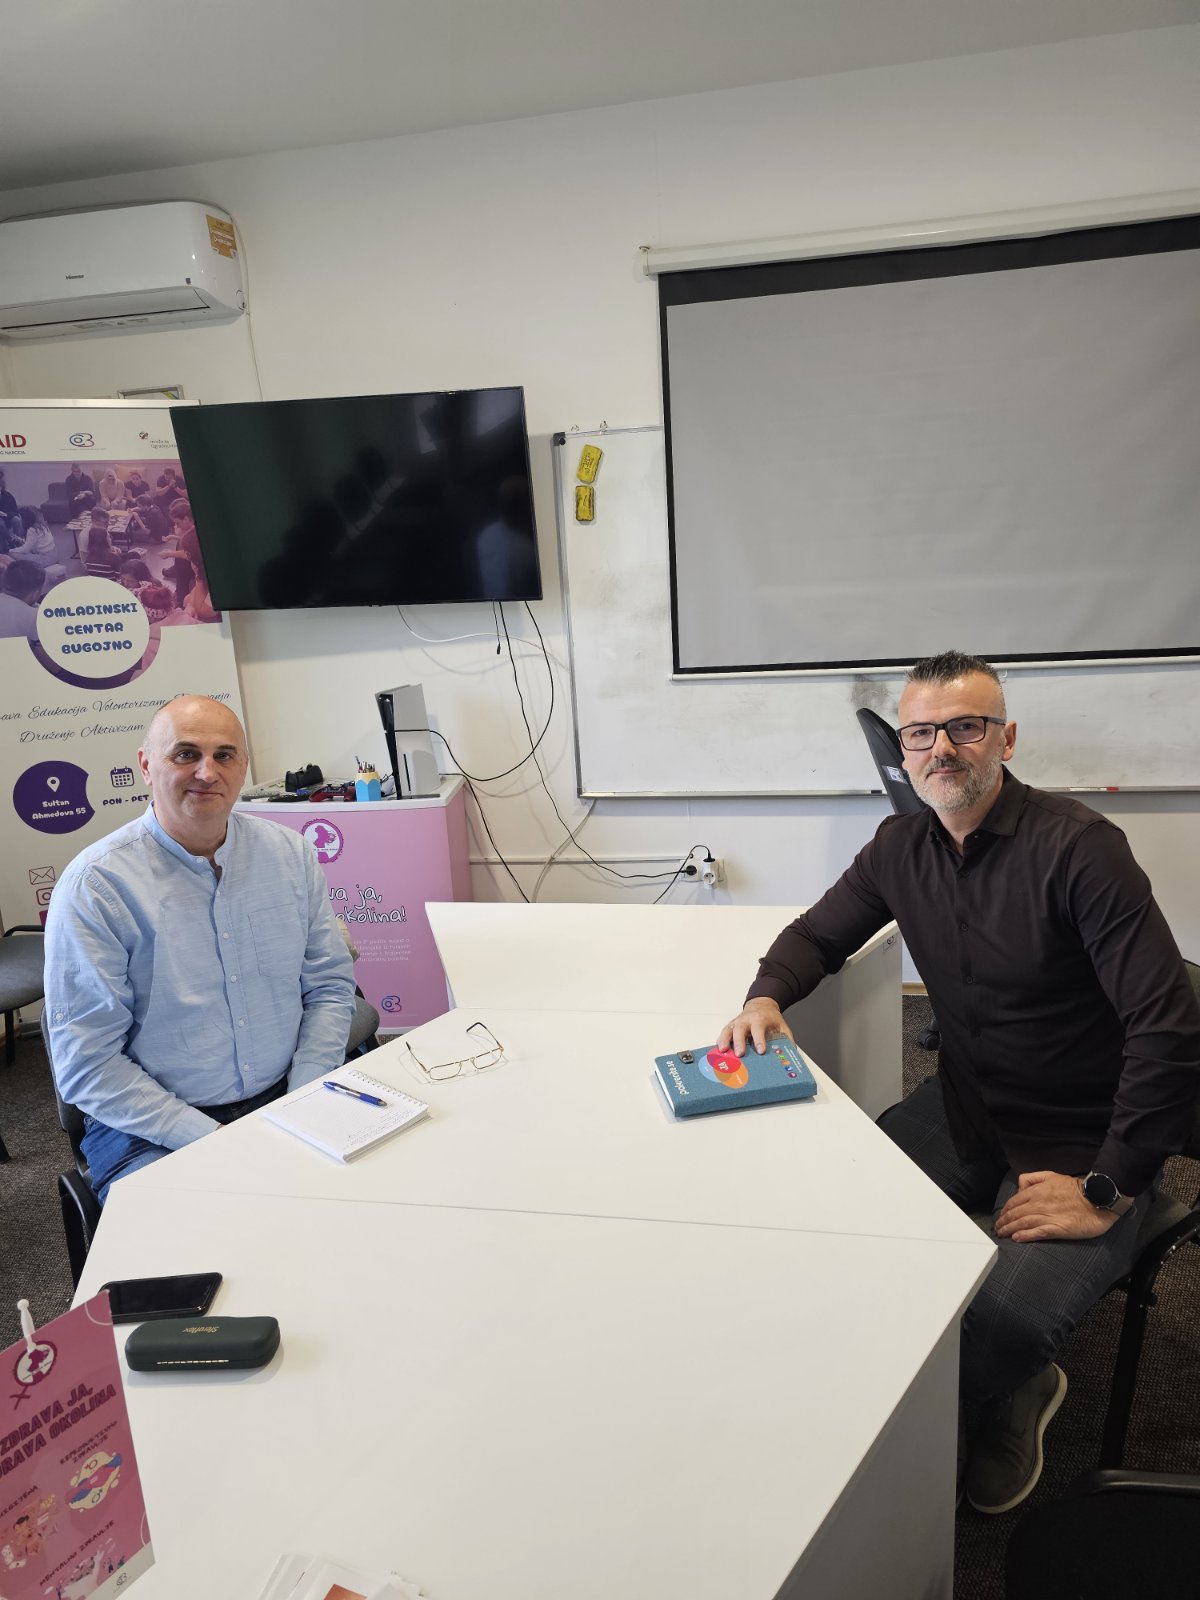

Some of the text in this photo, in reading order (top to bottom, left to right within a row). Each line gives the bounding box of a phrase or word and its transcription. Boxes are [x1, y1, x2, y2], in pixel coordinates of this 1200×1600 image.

[43, 602, 138, 618] OMLADINSKI
[64, 622, 124, 635] CENTAR
[61, 640, 133, 654] BUGOJNO
[27, 705, 88, 720] Edukacija
[92, 698, 166, 712] Volonterizam
[19, 723, 145, 743] Druženje Aktivizam
[42, 799, 70, 808] Sultan
[102, 798, 123, 806] PON
[131, 794, 150, 802] PET
[32, 810, 74, 820] Ahmedova
[354, 884, 383, 910] ja,
[67, 1383, 93, 1407] JA,
[0, 1384, 117, 1478] RAVA OKOLINA
[40, 1551, 77, 1586] MENTALNO
[80, 1520, 114, 1551] ZDRAVLJE
